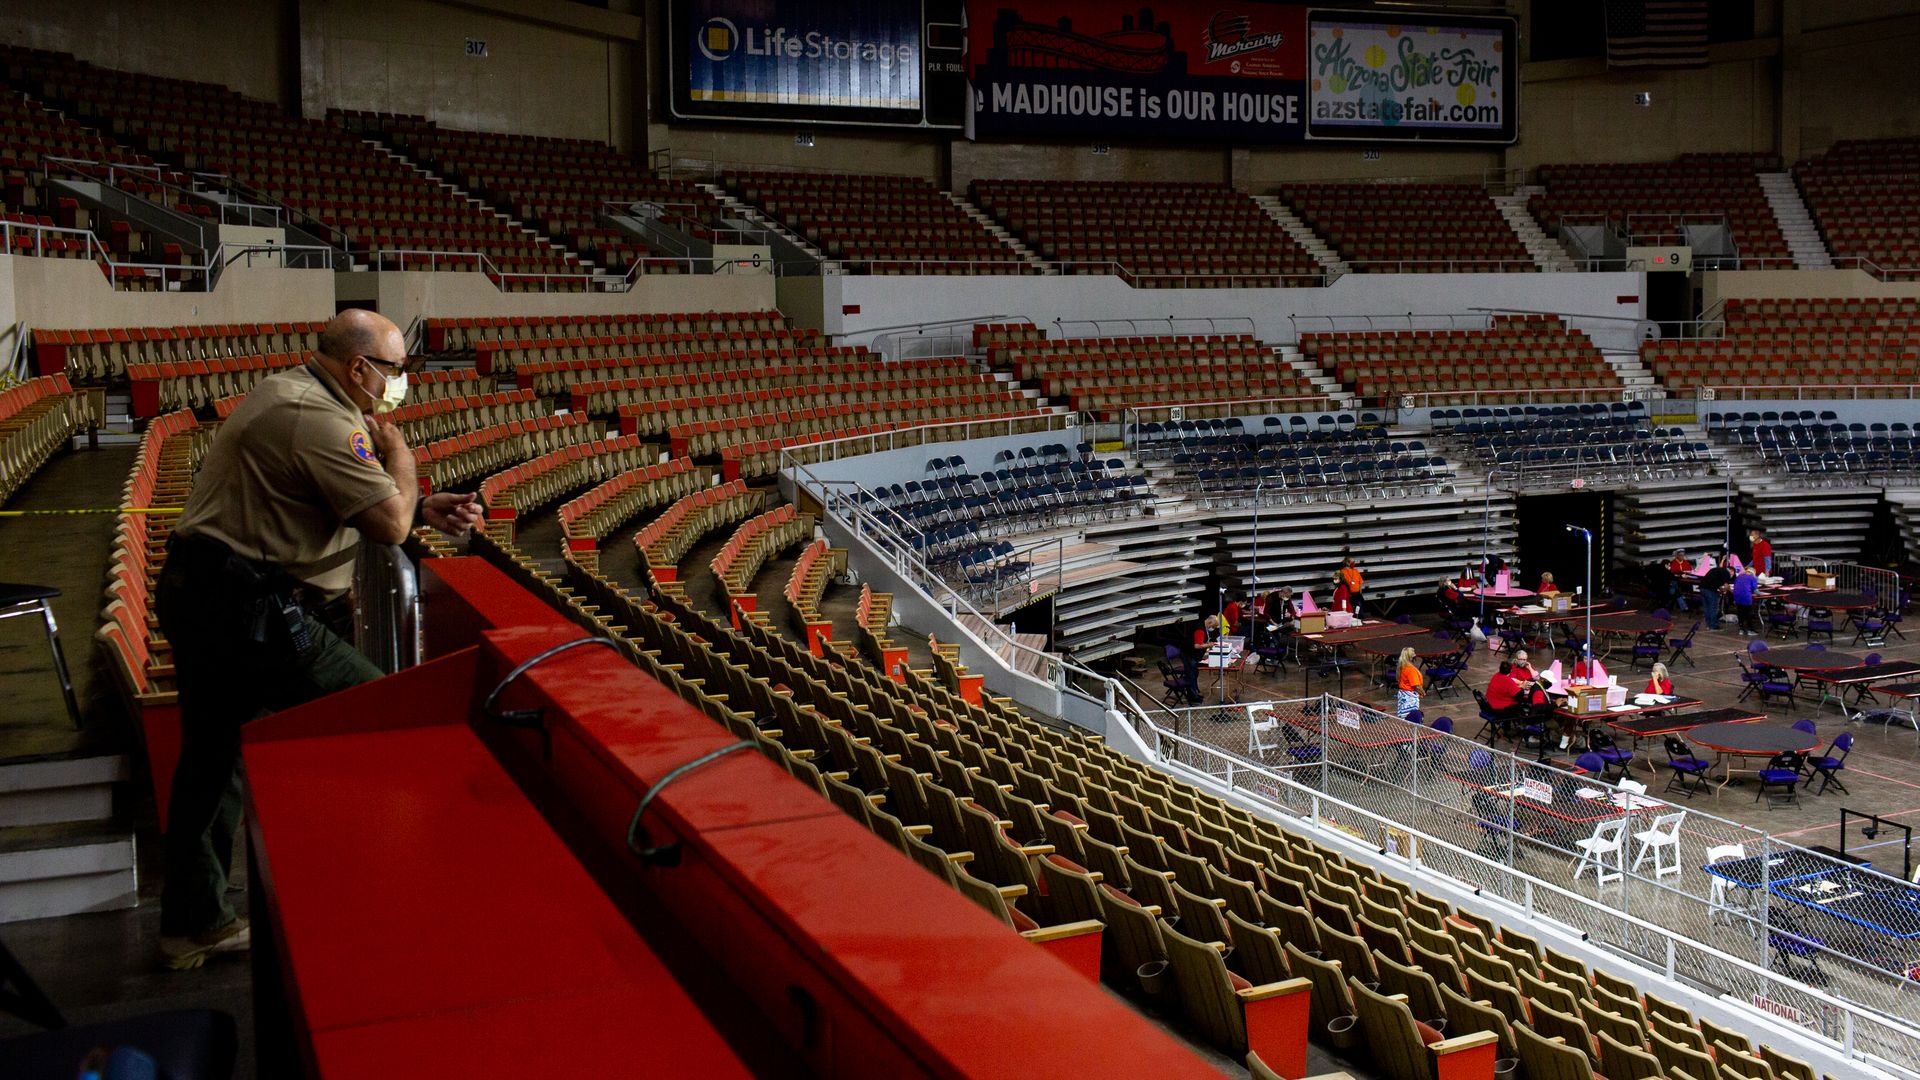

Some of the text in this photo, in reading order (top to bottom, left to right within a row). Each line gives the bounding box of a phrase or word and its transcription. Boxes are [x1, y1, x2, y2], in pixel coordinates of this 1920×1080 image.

[466, 41, 486, 55] 317
[1210, 33, 1283, 59] Mercury
[1314, 36, 1499, 92] Arizona State Fair
[992, 82, 1134, 117] MADHOUSE
[1140, 90, 1161, 117] is
[1167, 89, 1216, 121] OUR
[1223, 92, 1299, 124] HOUSE
[1316, 97, 1499, 123] azstatefair.com
[1670, 253, 1679, 264] 9
[1623, 391, 1633, 400] 210
[842, 575, 851, 583] 12
[1525, 780, 1551, 794] NATIONAL
[1754, 996, 1799, 1023] NATIONAL
